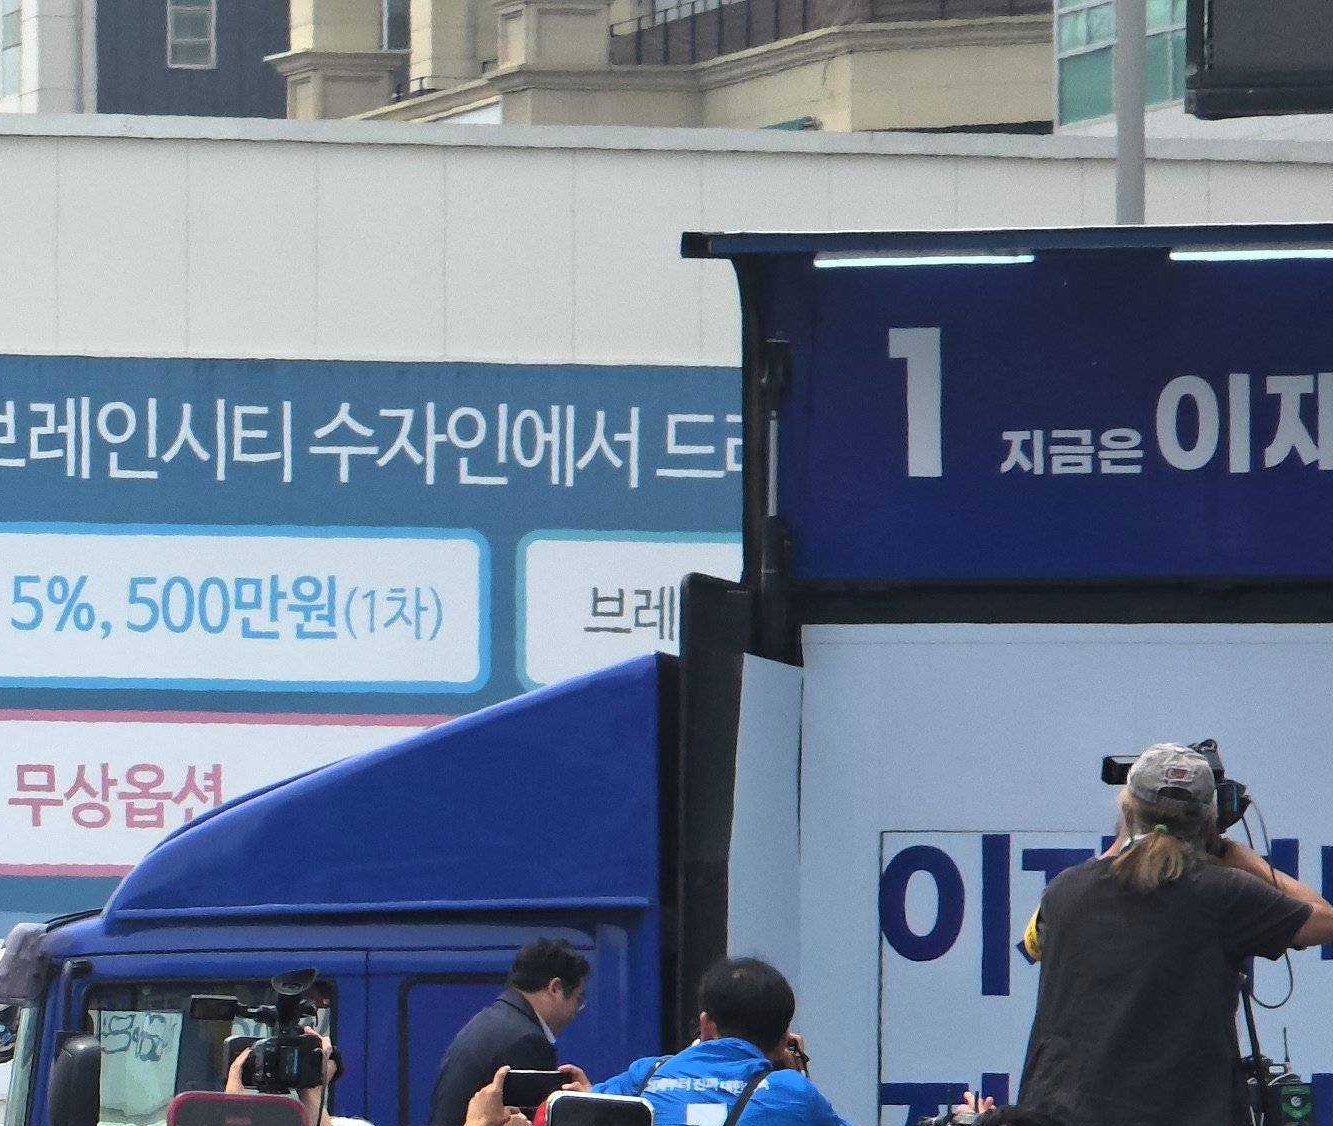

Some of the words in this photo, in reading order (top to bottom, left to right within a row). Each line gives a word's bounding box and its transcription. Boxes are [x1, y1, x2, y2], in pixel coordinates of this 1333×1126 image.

[888, 326, 943, 478] 1
[309, 401, 639, 488] 수자인에서
[1000, 427, 1144, 475] 지금은
[10, 575, 111, 642] 5%,
[126, 573, 443, 642] 500만원(1차)
[8, 763, 224, 829] 무상옵션
